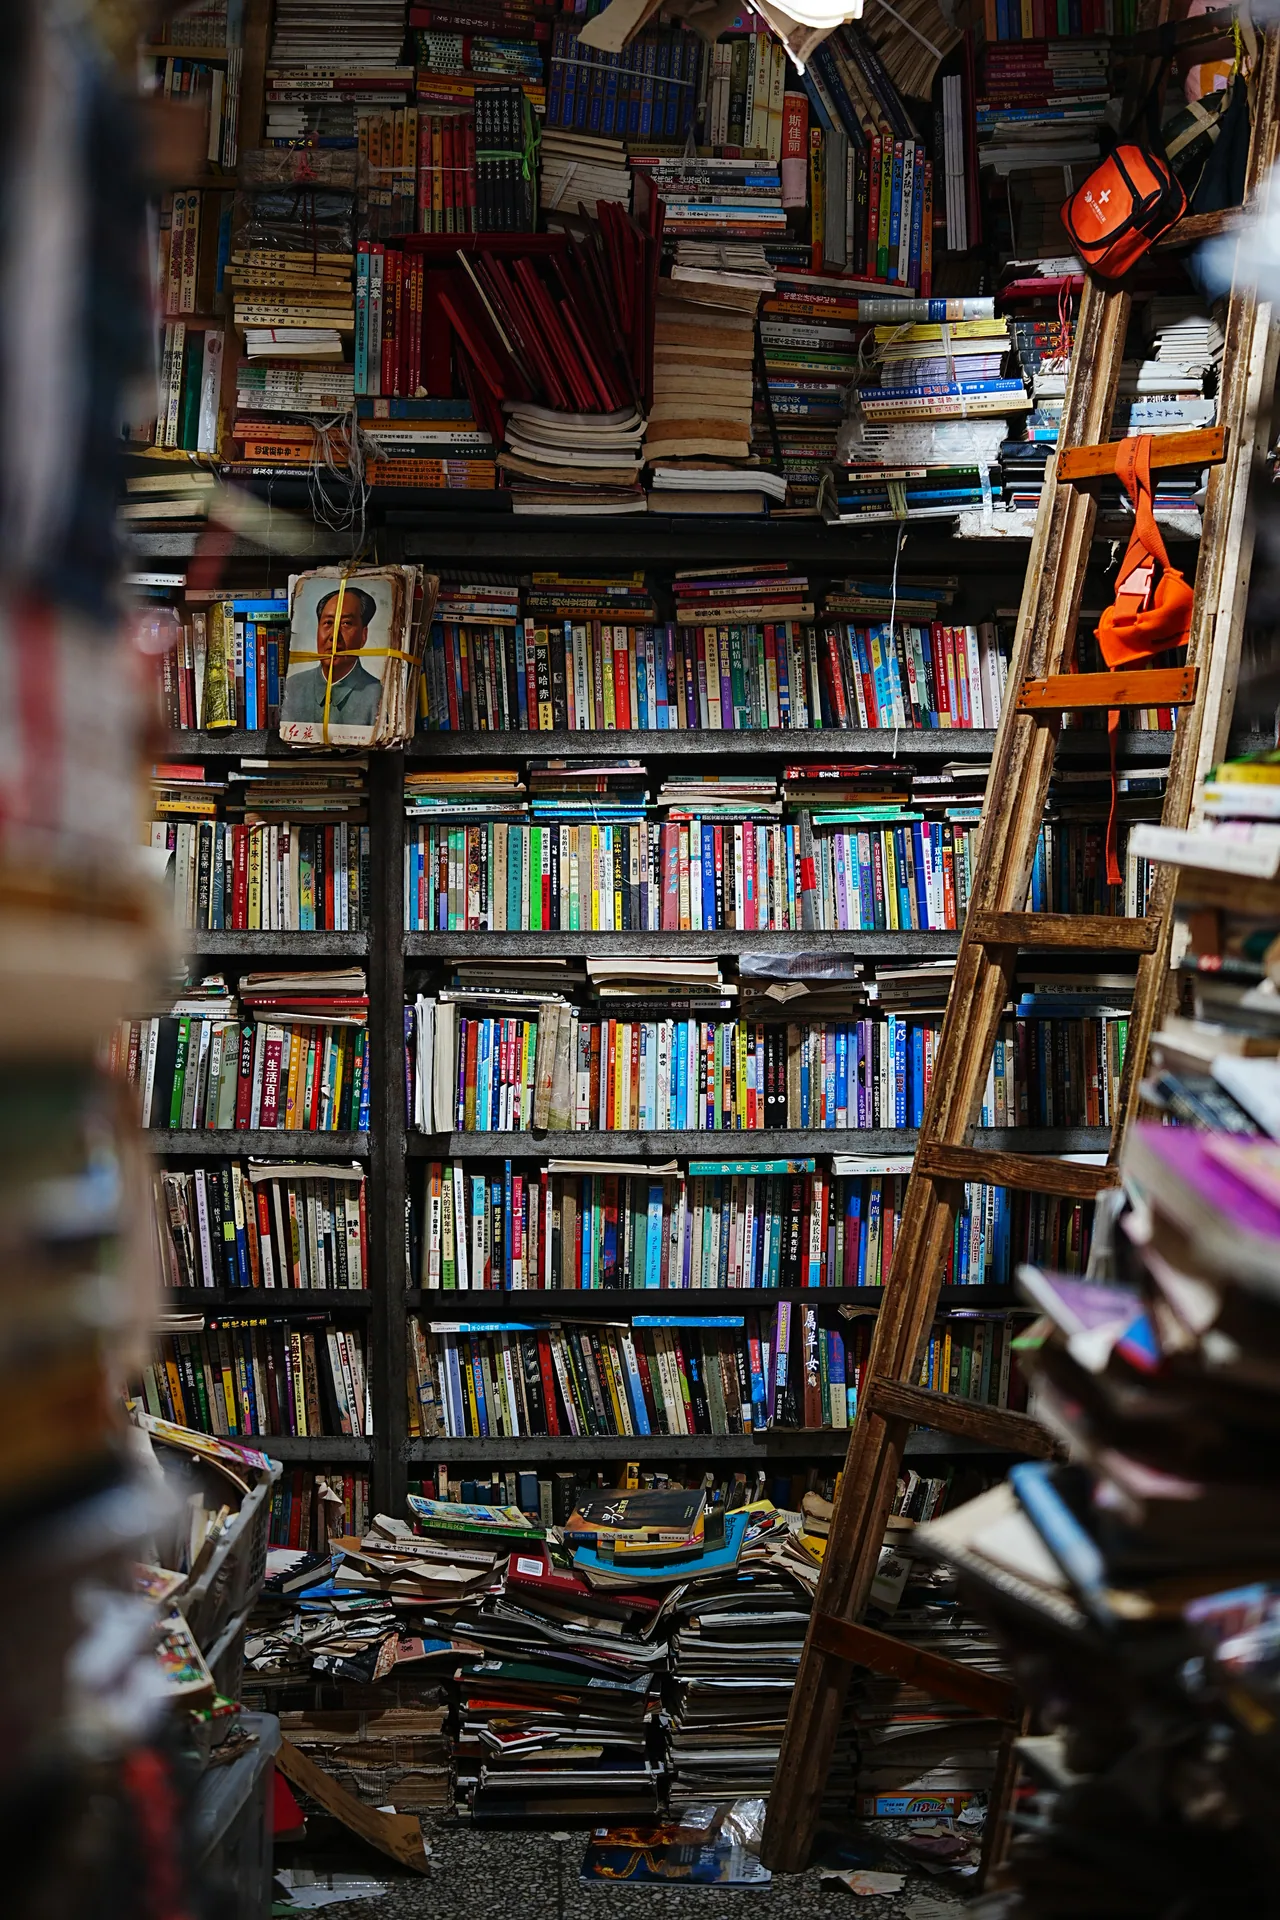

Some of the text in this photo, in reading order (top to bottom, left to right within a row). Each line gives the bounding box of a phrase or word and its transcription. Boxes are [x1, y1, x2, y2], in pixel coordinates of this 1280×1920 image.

[788, 115, 802, 152] 斯佳丽
[357, 276, 369, 298] 资本
[370, 277, 382, 298] 资本
[536, 647, 550, 700] 努尔哈赤
[288, 724, 314, 741] 红旗
[250, 836, 260, 885] 安乐公主
[703, 834, 714, 877] 宫廷恩仇记
[264, 1058, 279, 1109] 生活百科
[442, 1184, 452, 1235] 北大的花样年华
[870, 1193, 881, 1215] 时尚
[804, 1310, 819, 1372] 属羊女
[911, 1801, 947, 1814] 118114
